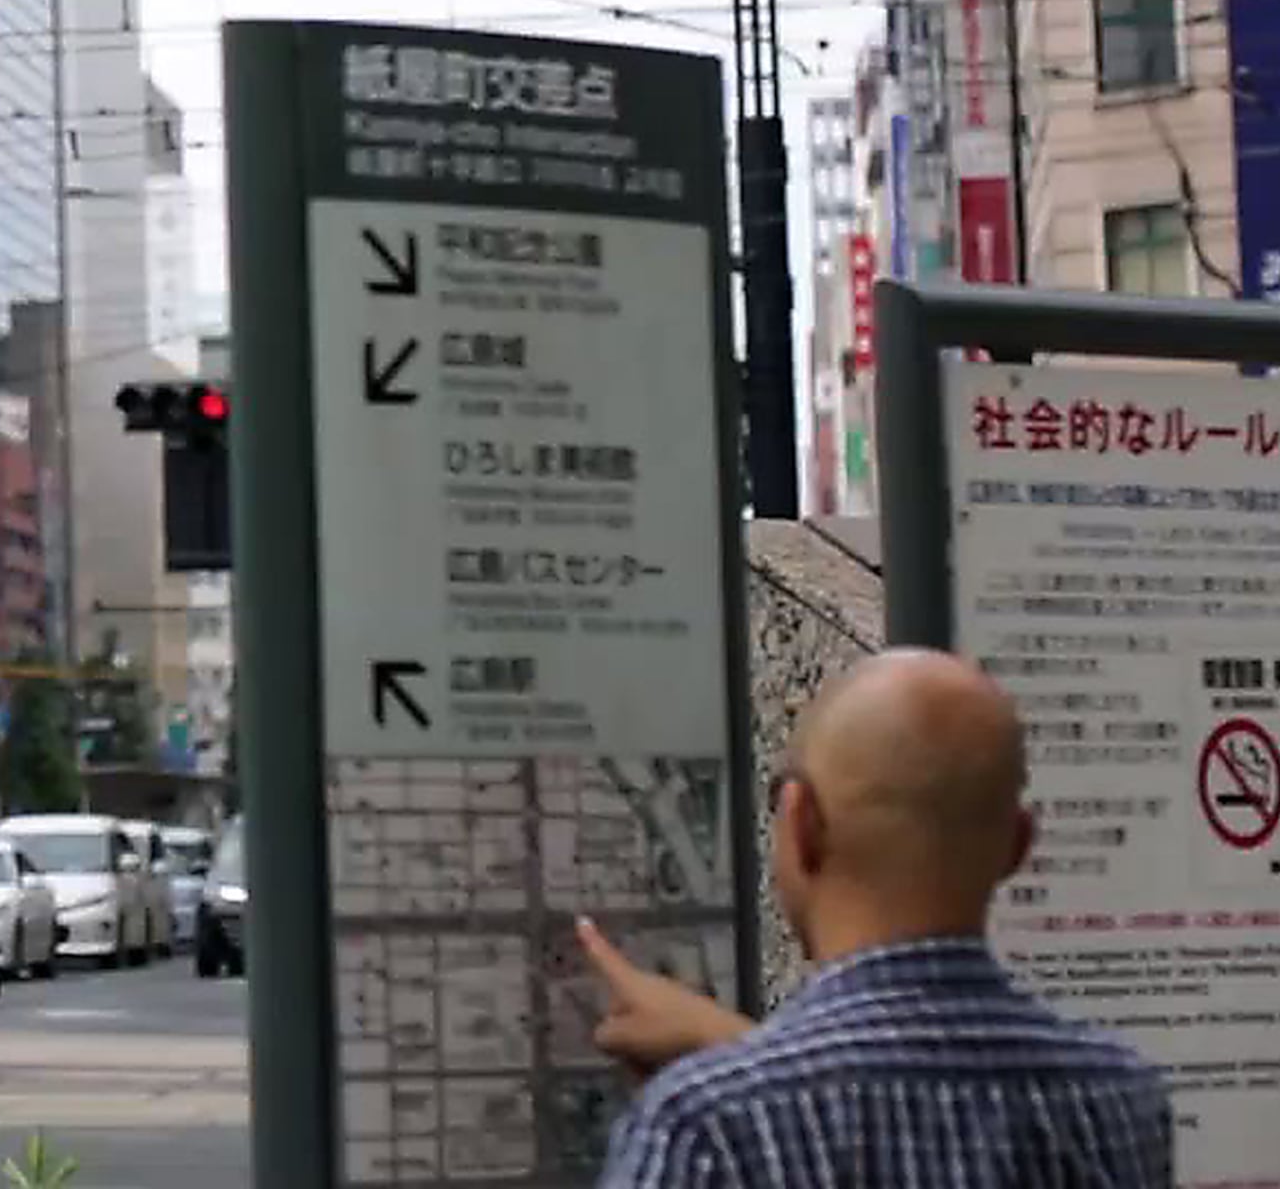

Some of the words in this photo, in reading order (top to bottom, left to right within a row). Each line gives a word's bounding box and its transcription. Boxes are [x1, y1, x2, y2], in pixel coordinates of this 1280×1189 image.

[972, 396, 1280, 455] 社会的なルール
